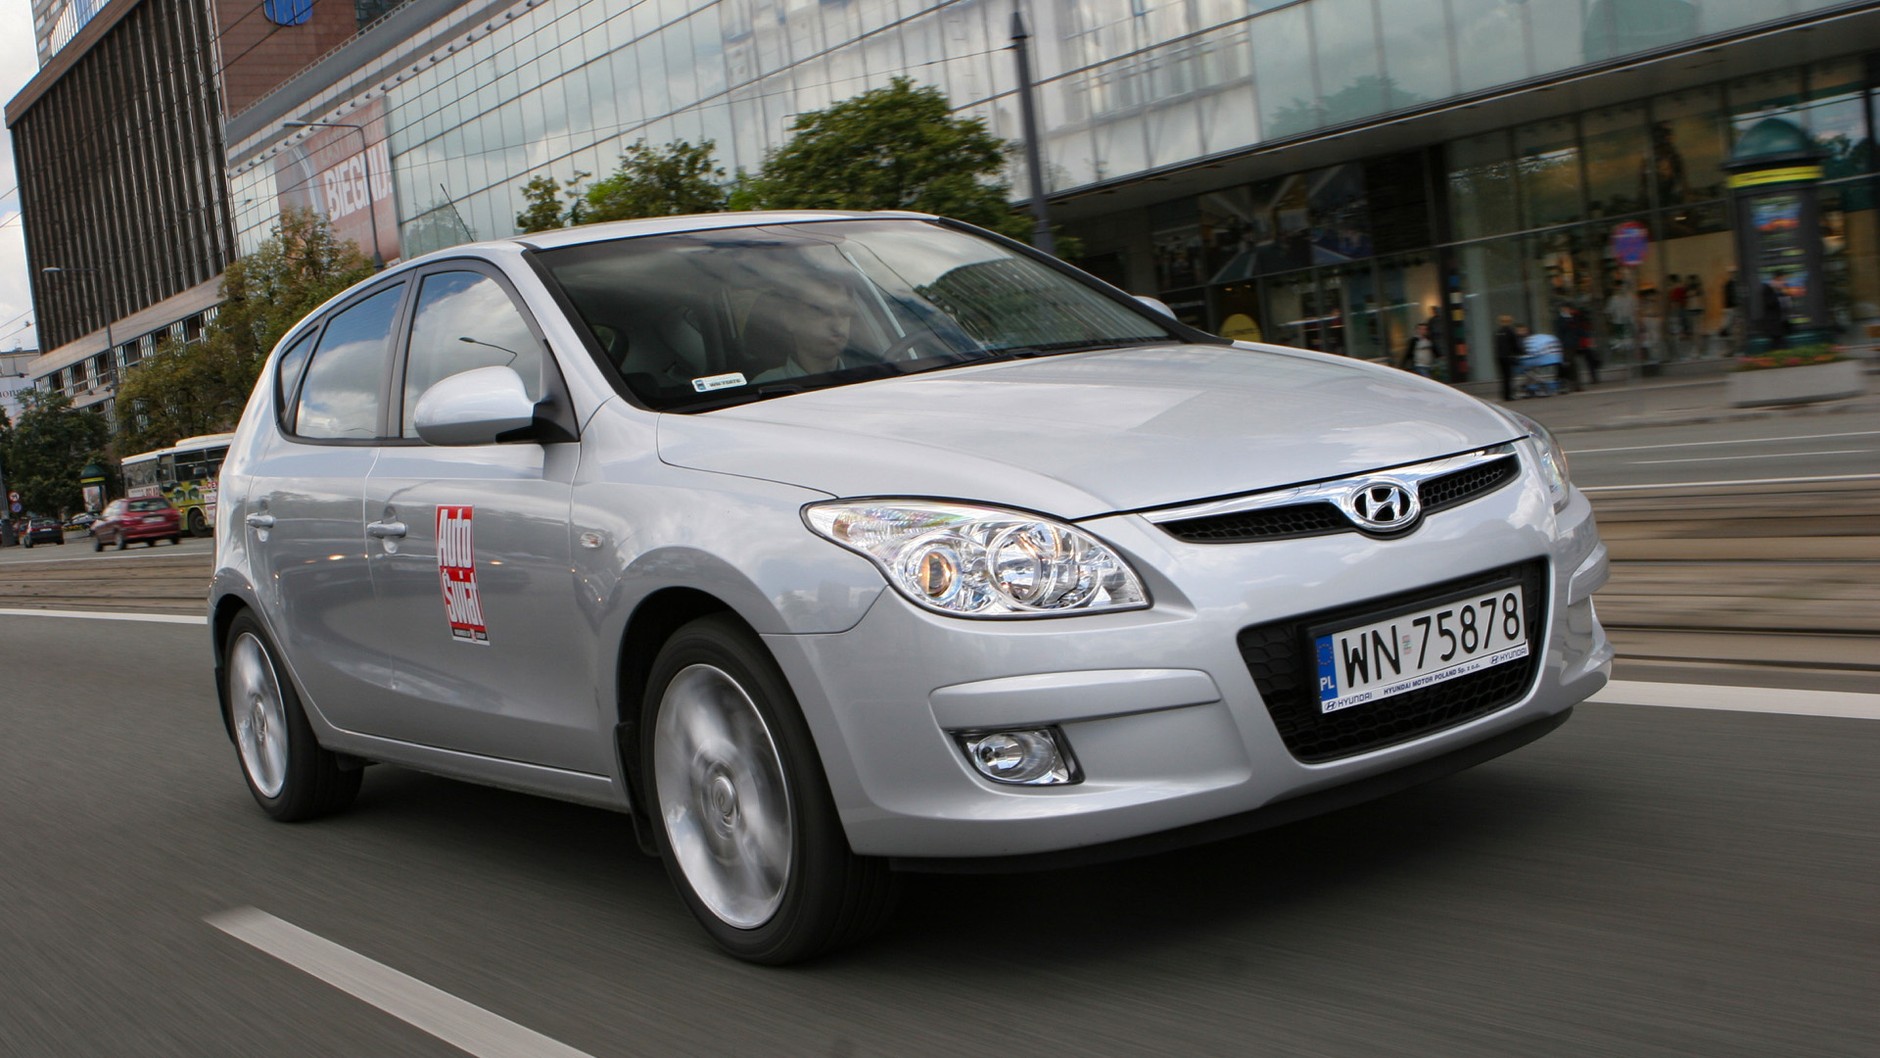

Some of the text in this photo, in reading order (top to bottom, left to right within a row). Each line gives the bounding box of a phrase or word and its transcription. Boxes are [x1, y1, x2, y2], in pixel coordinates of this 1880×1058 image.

[438, 508, 472, 568] Auto
[441, 568, 484, 626] Świat
[1340, 592, 1520, 689] WN 75878
[1499, 648, 1528, 662] HYUNDAI
[1319, 676, 1336, 692] PL
[1383, 682, 1411, 695] HYUNDAI
[1412, 675, 1434, 687] MOTOR
[1434, 668, 1457, 683] POLAND
[1337, 691, 1373, 708] HYUNDAI
